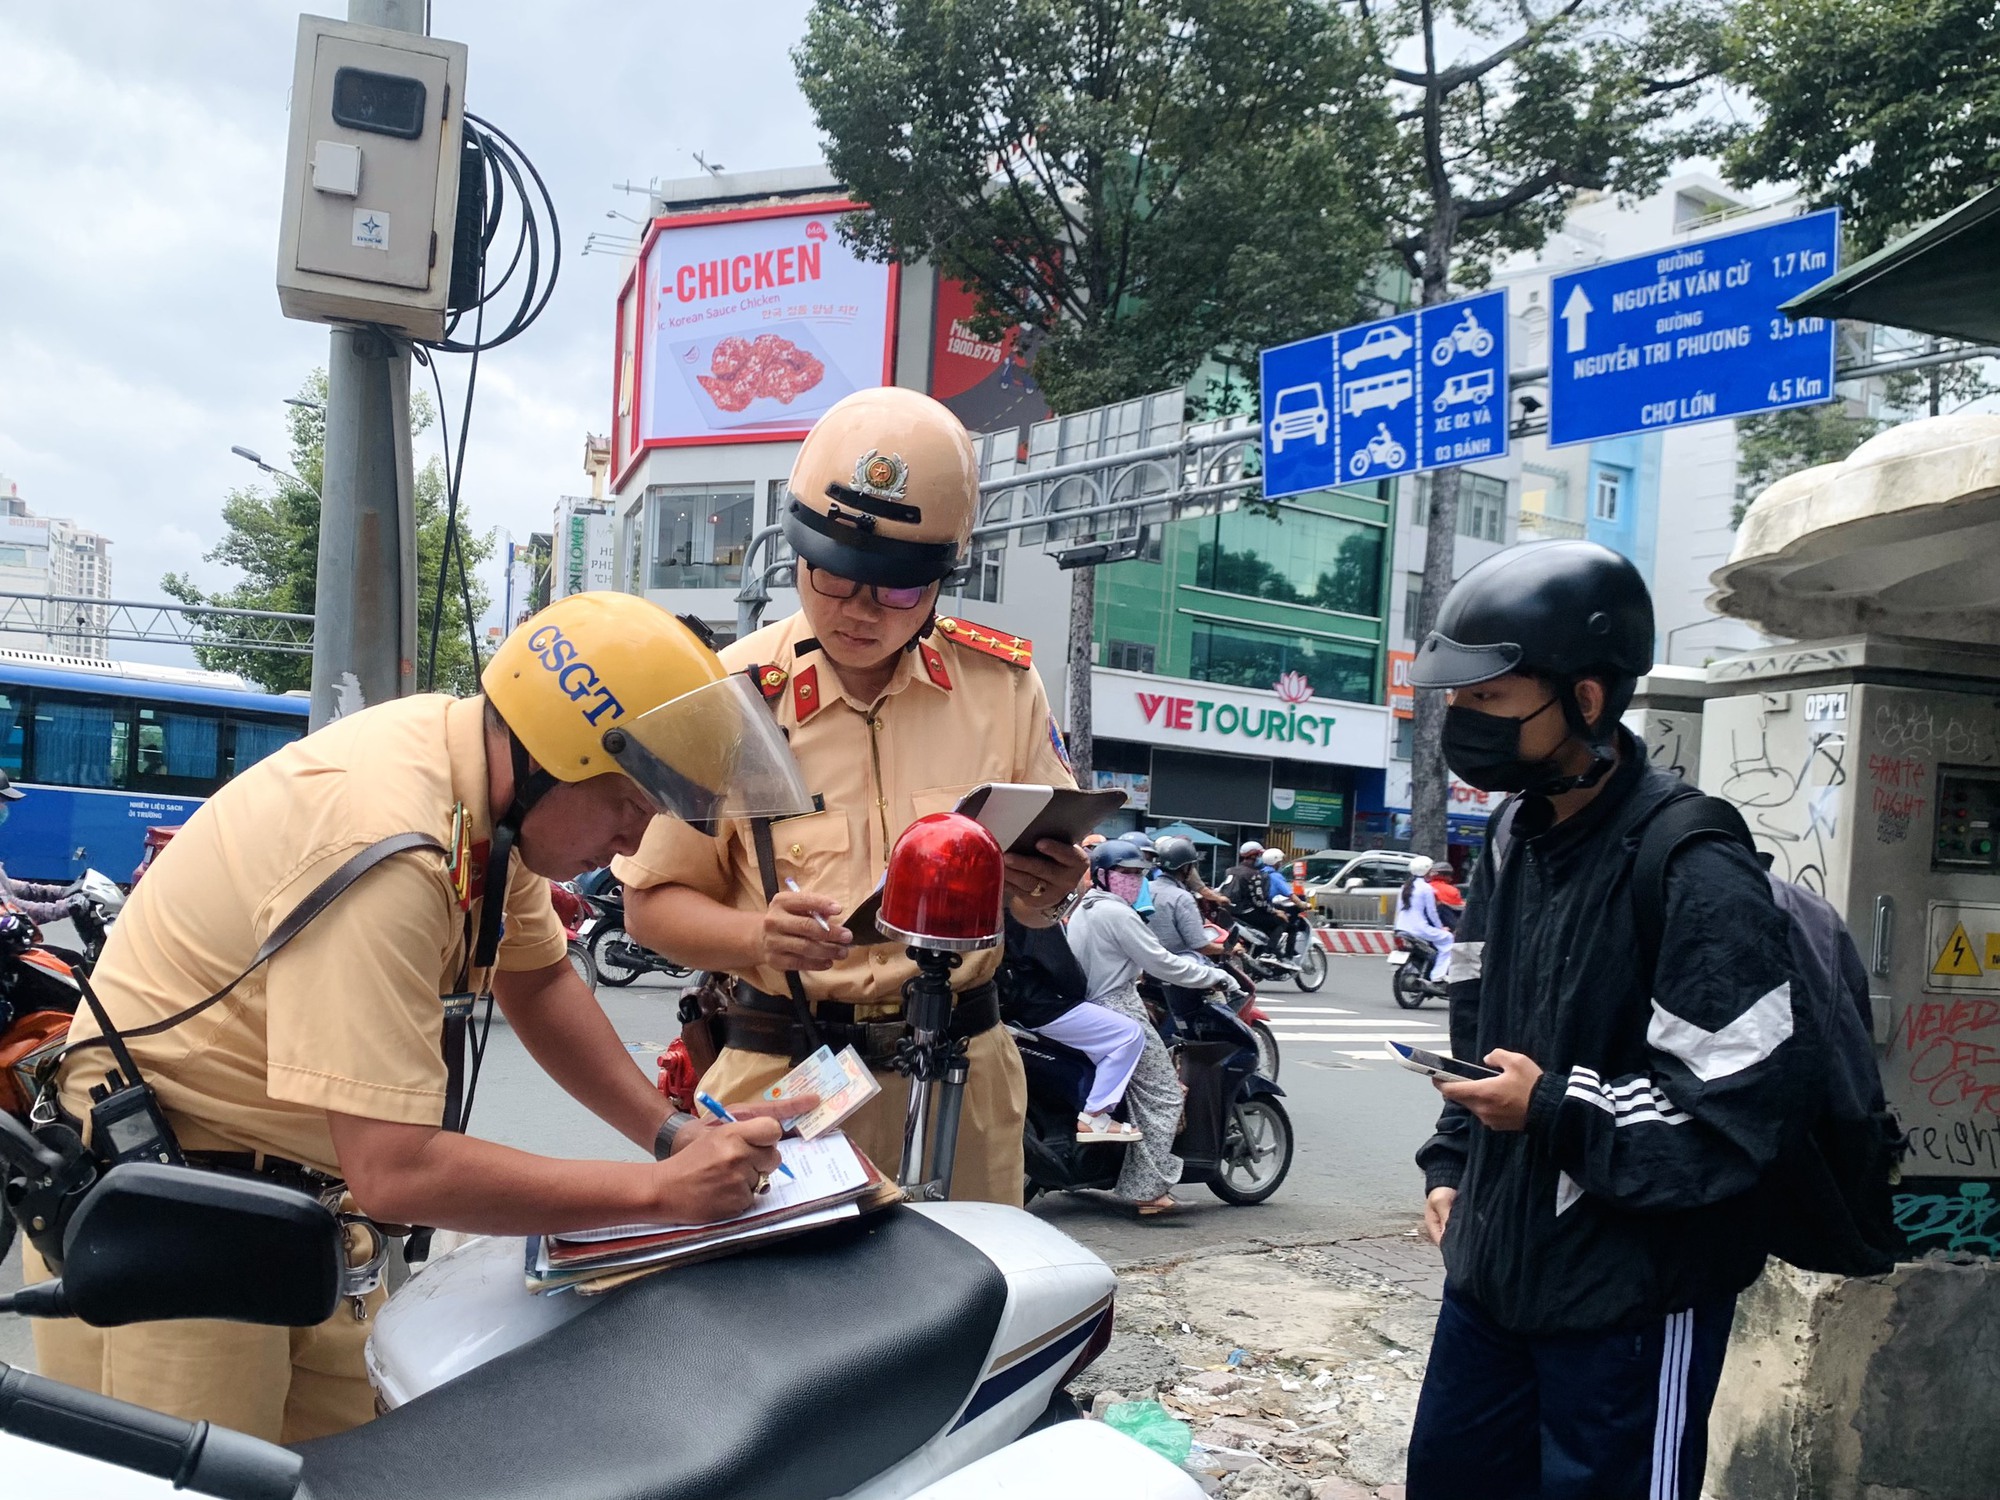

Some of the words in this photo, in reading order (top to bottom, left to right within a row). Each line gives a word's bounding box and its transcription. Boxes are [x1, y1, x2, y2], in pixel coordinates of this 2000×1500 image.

[1657, 249, 1705, 275] ĐƯỜNG
[1612, 275, 1681, 314] NGUYỄN
[1685, 270, 1721, 296] VĂN
[1772, 253, 1796, 279] 1,7
[1799, 250, 1827, 271] Km
[669, 312, 704, 328] Korean
[706, 305, 737, 319] Sauce
[740, 293, 781, 311] Chicken
[1656, 309, 1704, 335] ĐƯỜNG
[1573, 342, 1640, 380] NGUYỄN
[1643, 340, 1671, 366] TRI
[1676, 325, 1751, 360] PHƯƠNG
[1769, 318, 1794, 341] 3,5
[1798, 317, 1824, 336] Km
[1434, 415, 1452, 433] XE
[1454, 412, 1471, 429] 02
[1472, 404, 1492, 425] VÀ
[1641, 399, 1676, 426] CHỢ
[1681, 389, 1716, 418] LỚN
[1767, 381, 1791, 404] 4,5
[1796, 376, 1822, 397] Km
[1435, 445, 1451, 462] 03
[1454, 436, 1491, 459] BÁNH
[528, 625, 625, 727] CSGT
[1136, 692, 1336, 747] VIETOURIST
[129, 801, 149, 809] NHIÊN
[150, 802, 165, 811] LIỆU
[166, 804, 183, 812] SẠCH
